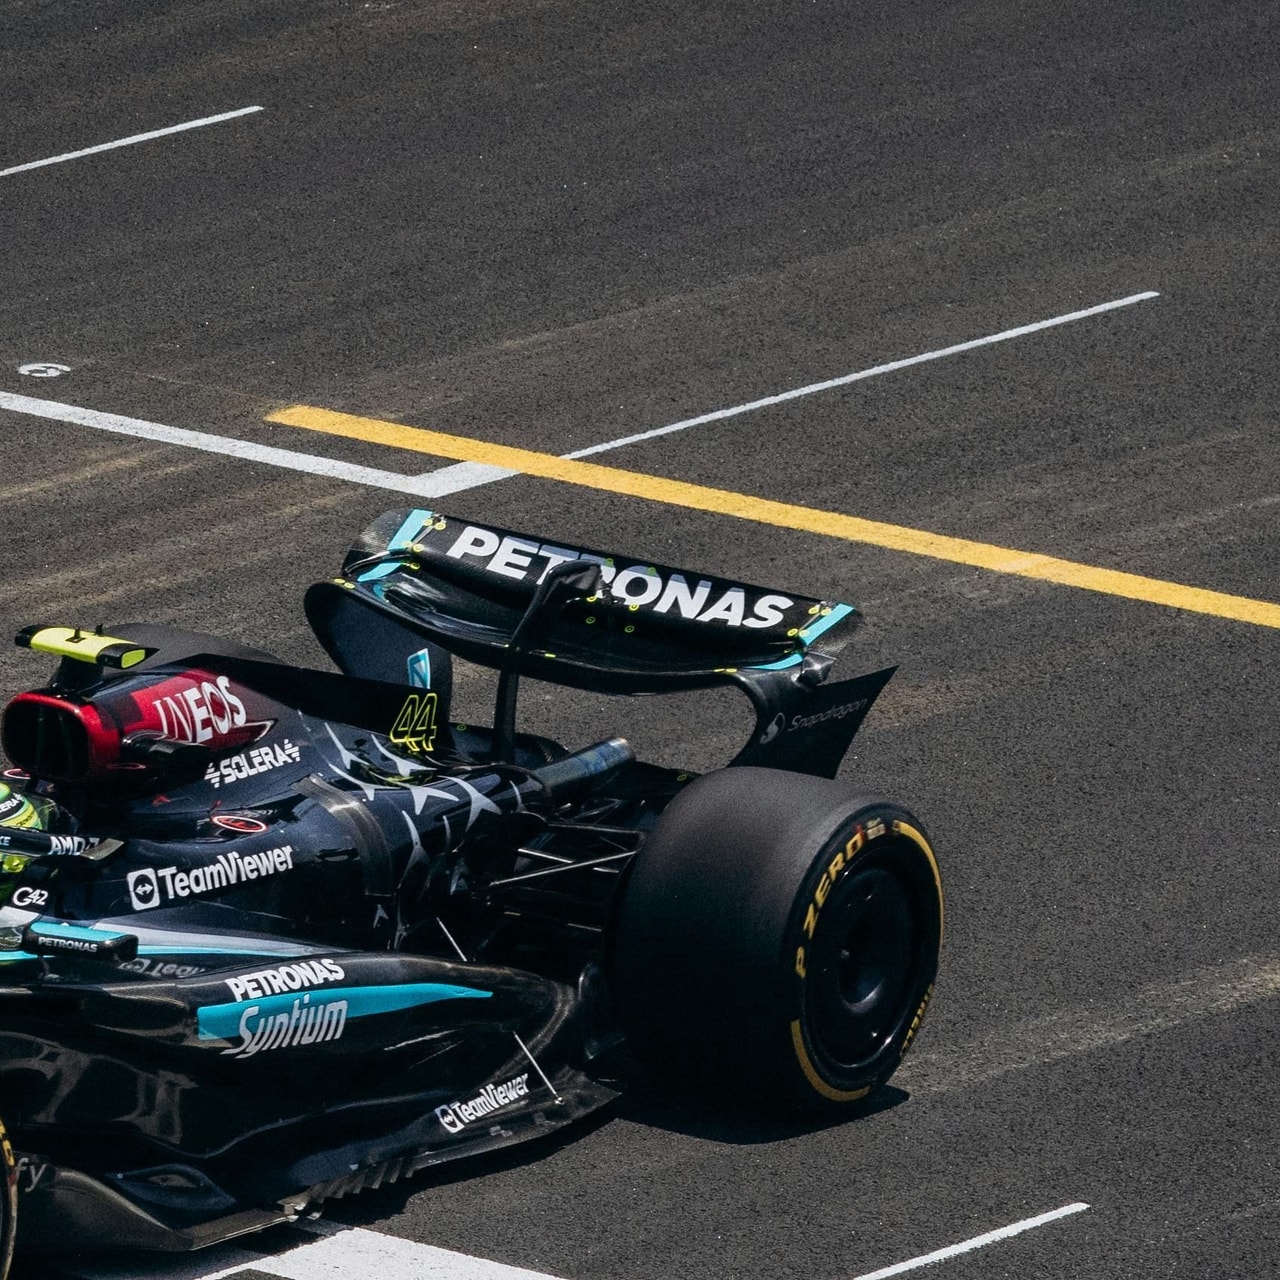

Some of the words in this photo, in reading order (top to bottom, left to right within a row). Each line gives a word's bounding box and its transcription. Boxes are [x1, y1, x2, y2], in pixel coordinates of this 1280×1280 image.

[446, 526, 793, 629] PETONAS
[152, 676, 246, 744] INEOS
[390, 693, 437, 752] 44
[219, 743, 293, 784] SOLERA
[47, 836, 86, 856] AMD
[157, 845, 294, 899] TeamViewer
[13, 887, 48, 906] G42
[38, 936, 99, 953] PETRONAS
[225, 958, 346, 1002] PETRONAS
[219, 994, 348, 1059] Syntium
[450, 1072, 530, 1124] TeamViewer
